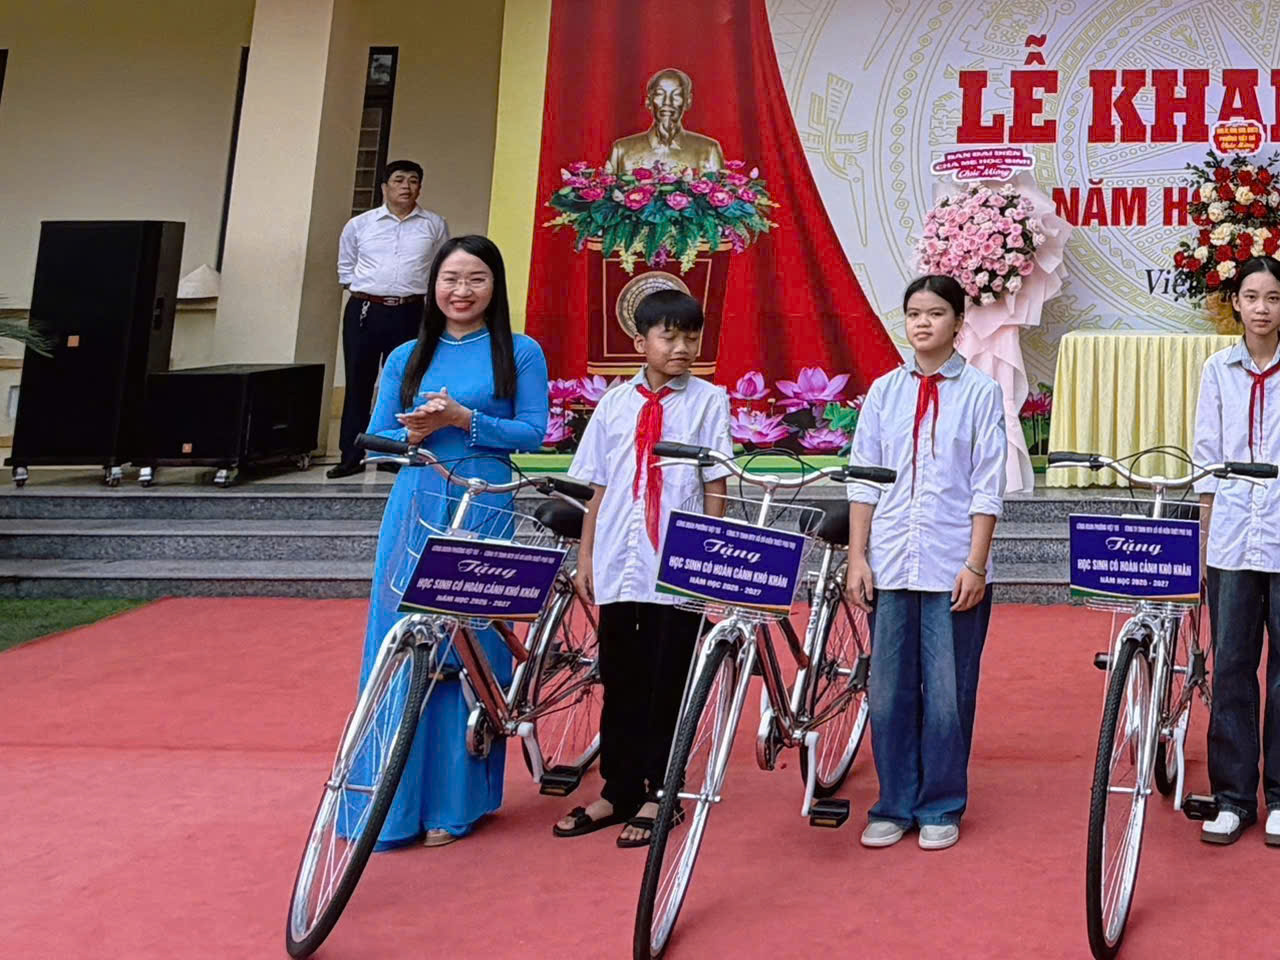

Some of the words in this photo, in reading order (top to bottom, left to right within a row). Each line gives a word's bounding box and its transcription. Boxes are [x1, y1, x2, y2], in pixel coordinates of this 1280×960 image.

[956, 35, 1059, 144] LỄ
[1052, 178, 1147, 227] NĂM
[703, 539, 761, 563] Tặng
[1105, 537, 1162, 555] Tặng
[458, 560, 518, 579] Tặng
[669, 556, 683, 570] HỌC
[684, 559, 701, 571] SINH
[702, 560, 713, 573] CÓ
[713, 563, 733, 577] HOÀN
[753, 570, 768, 585] KHÓ
[1077, 559, 1091, 572] HỌC
[1092, 560, 1108, 571] SINH
[1109, 558, 1119, 571] CÓ
[1119, 560, 1138, 573] HOÀN
[1159, 562, 1172, 575] KHÓ
[707, 580, 722, 589] HỌC
[1116, 577, 1130, 585] HỌC
